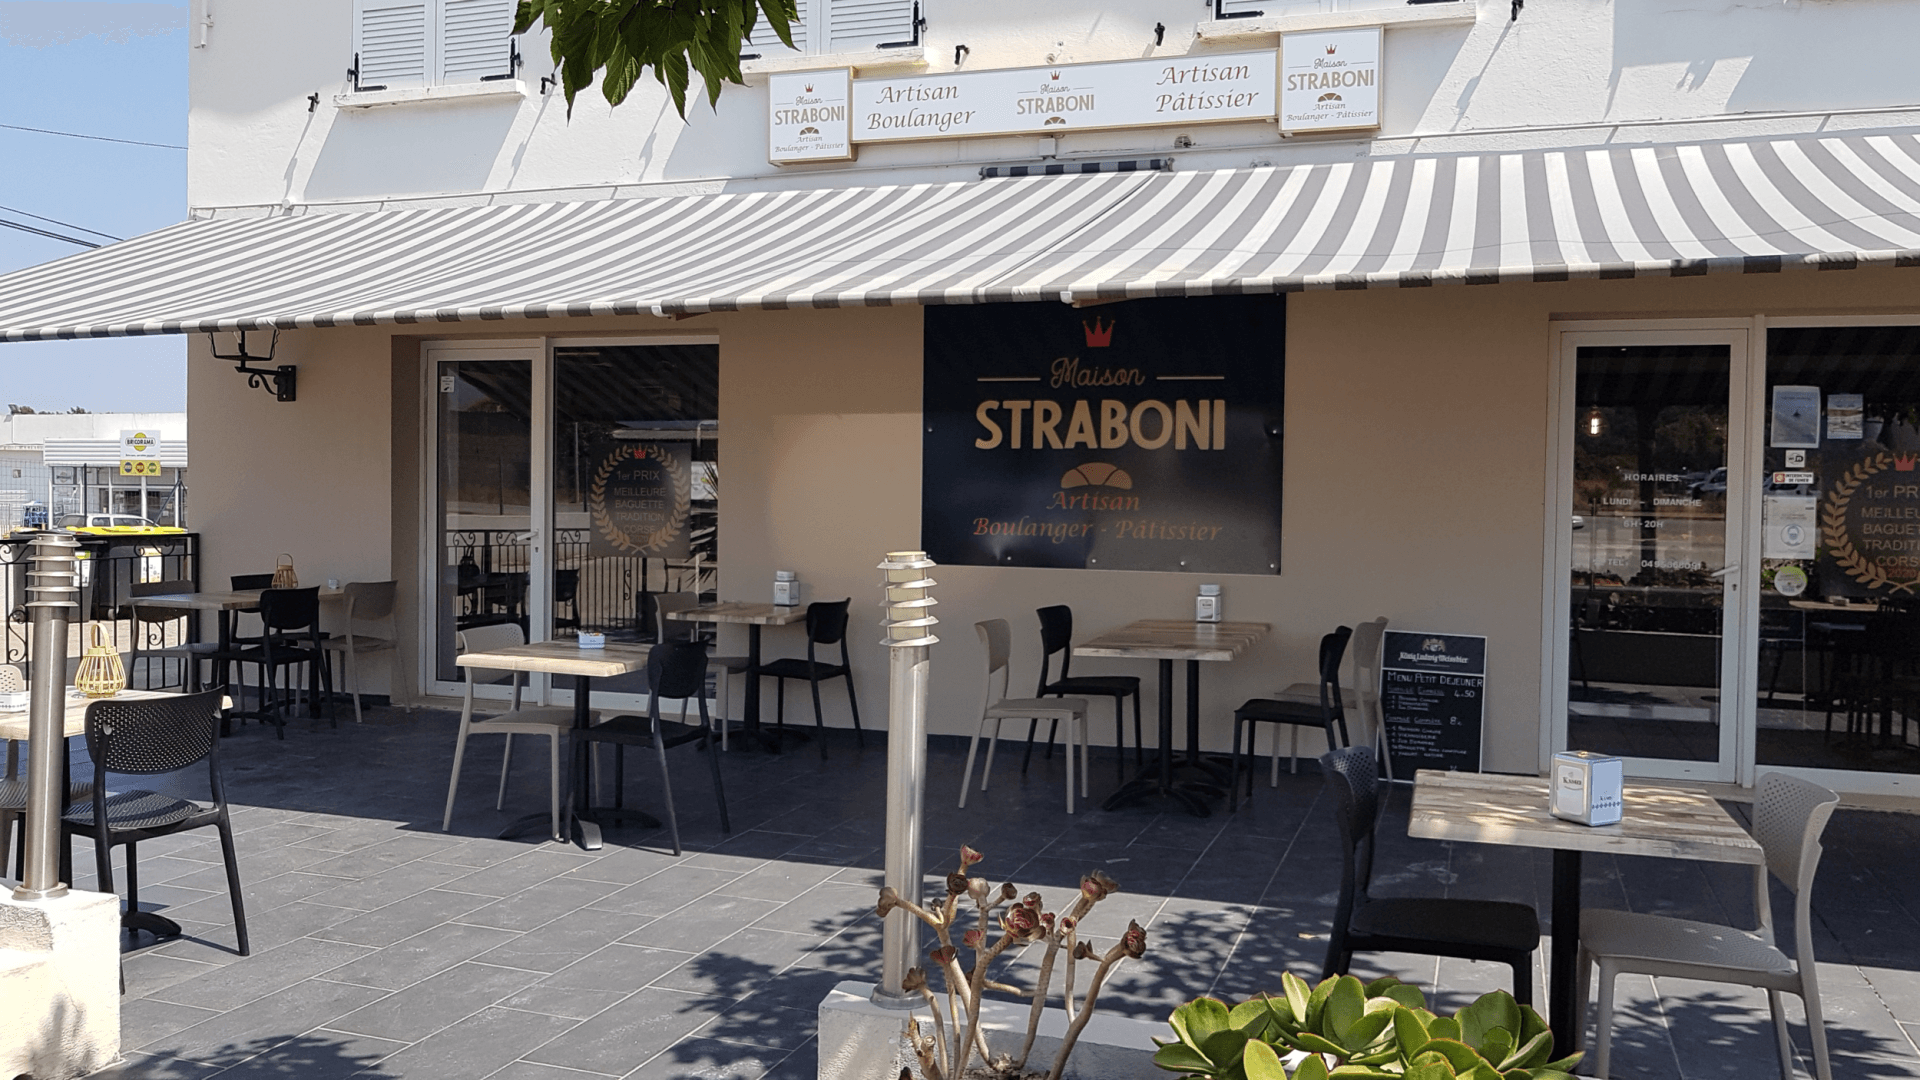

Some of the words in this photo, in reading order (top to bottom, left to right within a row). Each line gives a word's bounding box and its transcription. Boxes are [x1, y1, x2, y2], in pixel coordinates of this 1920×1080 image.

[1314, 58, 1347, 69] Maison
[1155, 63, 1250, 86] Artisan
[1287, 69, 1374, 91] STRABONI
[875, 84, 959, 104] Artisan
[1040, 84, 1071, 95] Maison
[796, 96, 823, 107] Maison
[1017, 94, 1095, 115] STRABONI
[1156, 89, 1260, 113] Pâtissier
[1312, 103, 1346, 111] Artisan
[775, 105, 845, 125] STRABONI
[867, 108, 976, 132] Boulanger
[1286, 113, 1329, 122] Boulanger
[1336, 110, 1373, 119] Pâtissier
[796, 135, 823, 143] Artisan
[775, 144, 809, 153] Boulanger
[815, 142, 844, 151] Pâtissier
[1050, 357, 1145, 389] Maison
[975, 399, 1226, 450] STRABONI
[633, 470, 660, 480] PRIX
[1624, 473, 1680, 482] HORAIRES
[613, 487, 667, 497] MEILLEURE
[1866, 486, 1889, 499] 1er
[615, 500, 664, 509] BAGUETTE
[1046, 491, 1140, 512] Artisan
[1603, 498, 1632, 506] LUNDI
[1653, 498, 1702, 507] DIMANCHE
[616, 512, 664, 522] TRADITION
[623, 525, 656, 534] CORSE
[972, 516, 1093, 544] Boulanger
[1115, 519, 1223, 541] Pâtissier
[1388, 671, 1413, 682] MENU
[1414, 672, 1437, 684] PETIT
